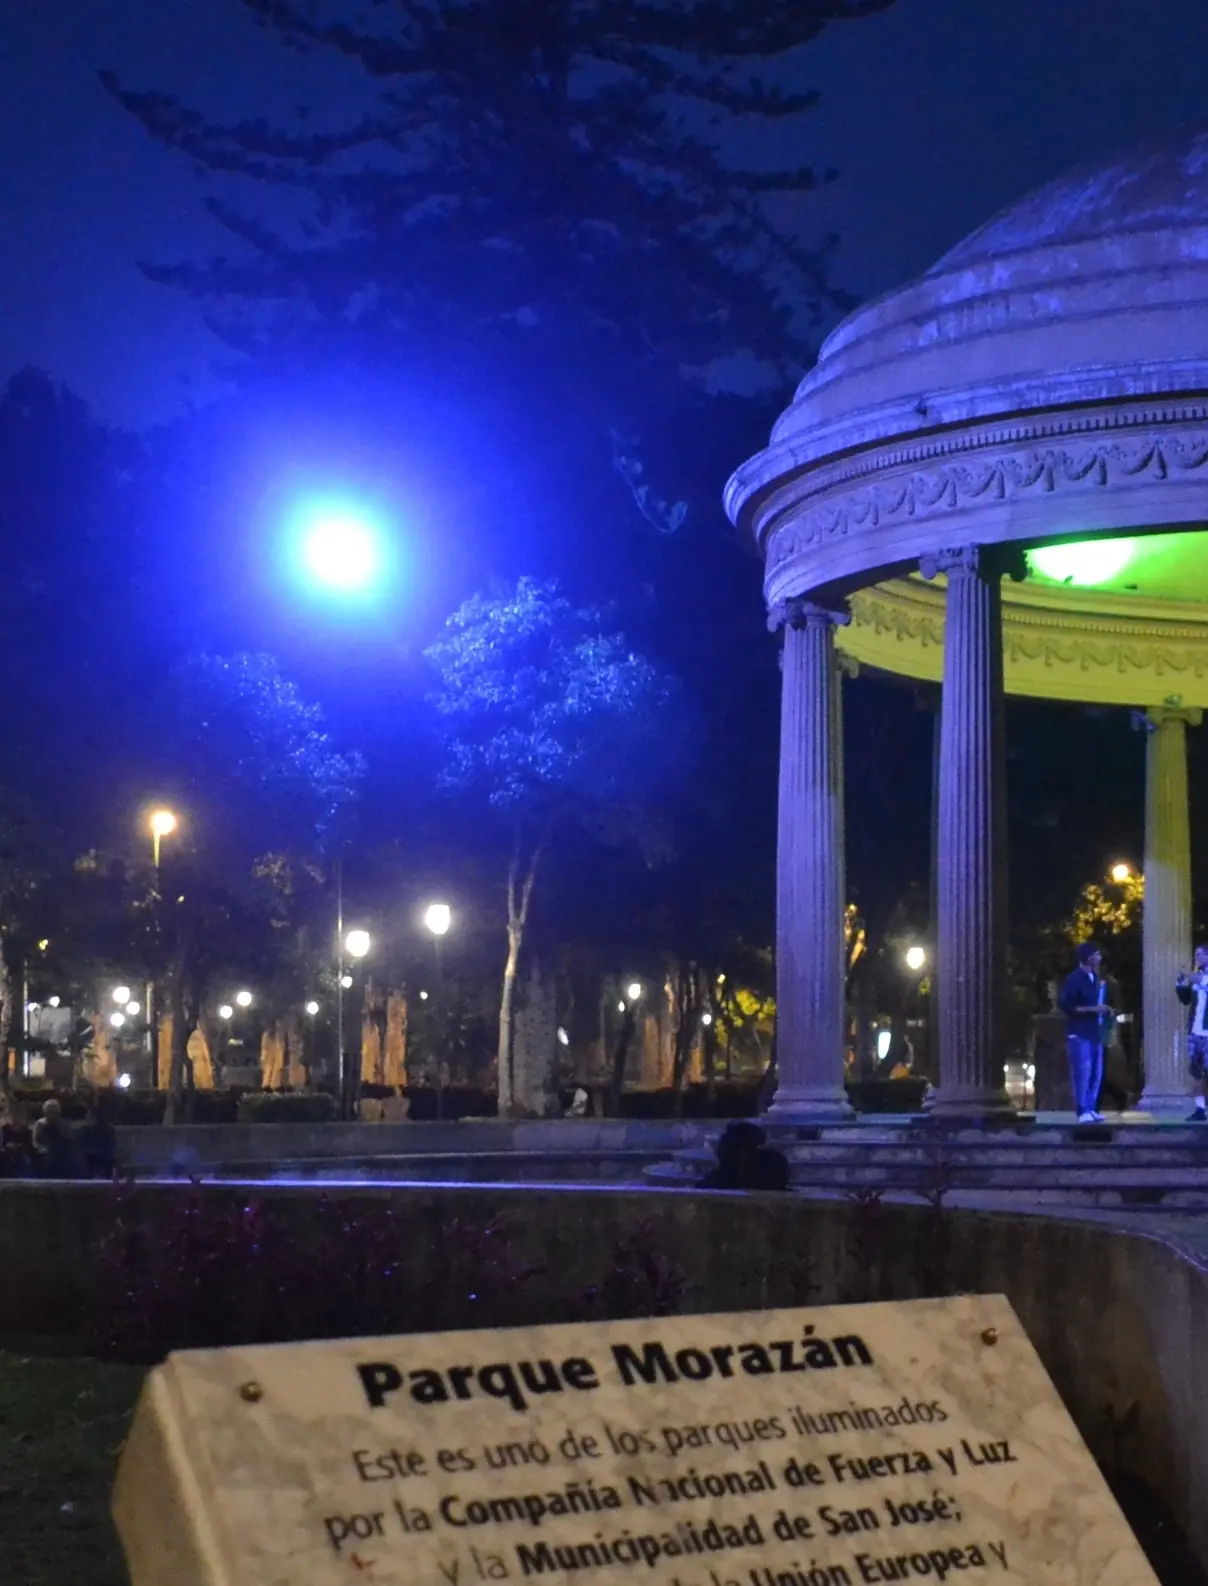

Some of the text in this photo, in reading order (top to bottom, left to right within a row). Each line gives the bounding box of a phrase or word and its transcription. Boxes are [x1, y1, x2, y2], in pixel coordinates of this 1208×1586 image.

[356, 1324, 873, 1411] Parque Morazán
[353, 1397, 948, 1482] Este es uno de los parques iluminados
[323, 1510, 384, 1551] por
[393, 1497, 432, 1533] la
[784, 1456, 826, 1488] de
[827, 1449, 933, 1483] Fuerza
[937, 1447, 958, 1476] y
[960, 1437, 1018, 1467] Luz
[437, 1558, 460, 1586] y
[469, 1544, 509, 1582] la
[514, 1513, 765, 1577] Municipalidad
[773, 1509, 817, 1542] de
[818, 1503, 880, 1537] San
[885, 1489, 962, 1528] José;
[855, 1543, 986, 1584] Europea
[987, 1539, 1010, 1571] y
